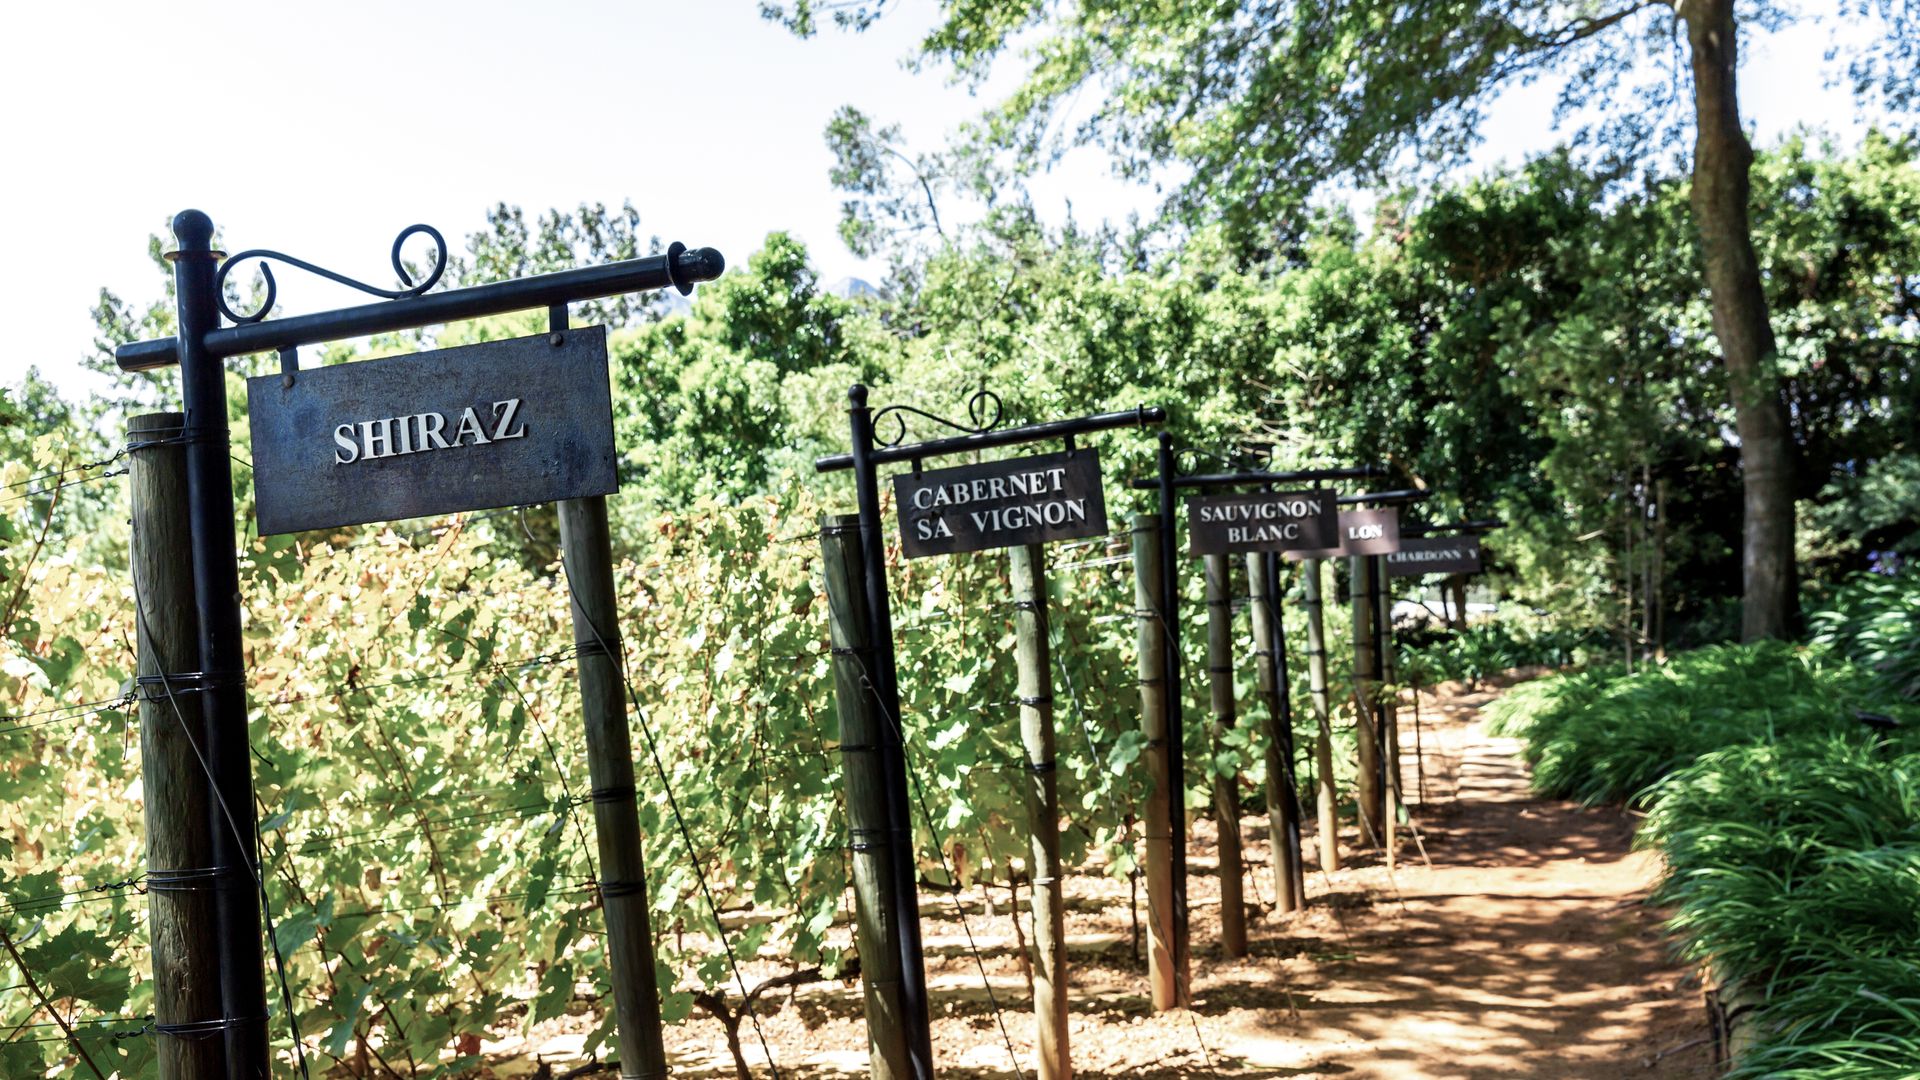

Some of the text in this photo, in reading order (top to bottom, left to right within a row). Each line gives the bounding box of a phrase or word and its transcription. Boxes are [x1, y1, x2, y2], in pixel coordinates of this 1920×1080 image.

[333, 398, 525, 465] SHIRAZ
[913, 468, 1066, 510] CABERNET
[1200, 500, 1322, 522] SAUVIGNON
[1228, 523, 1299, 543] BLANC
